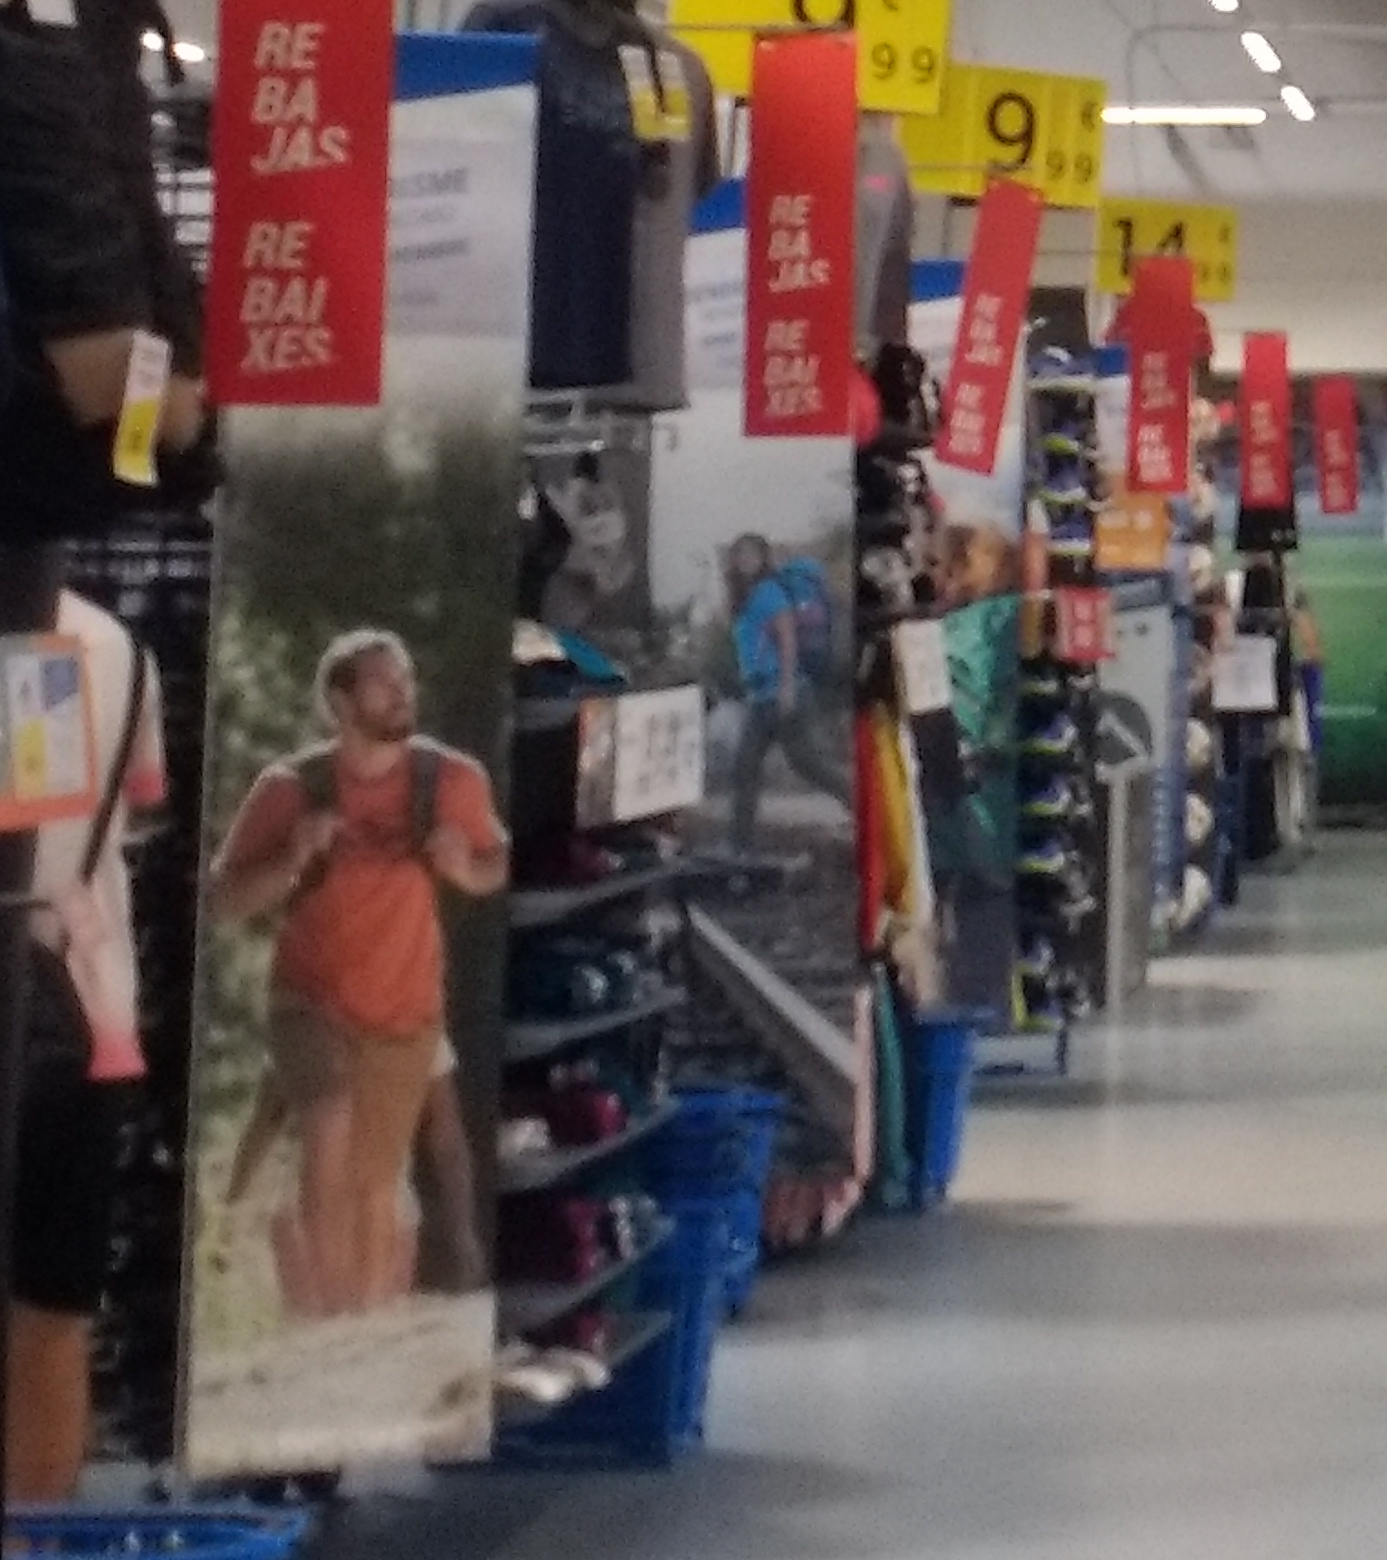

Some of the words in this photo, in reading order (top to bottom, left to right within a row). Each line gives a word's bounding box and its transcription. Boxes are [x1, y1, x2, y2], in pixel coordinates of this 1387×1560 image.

[254, 21, 325, 70] RE
[253, 75, 318, 124] BA
[251, 124, 350, 175] JAS
[986, 91, 1036, 173] 9
[243, 220, 313, 270] RE
[240, 275, 328, 323] BAI
[240, 326, 334, 372] XES
